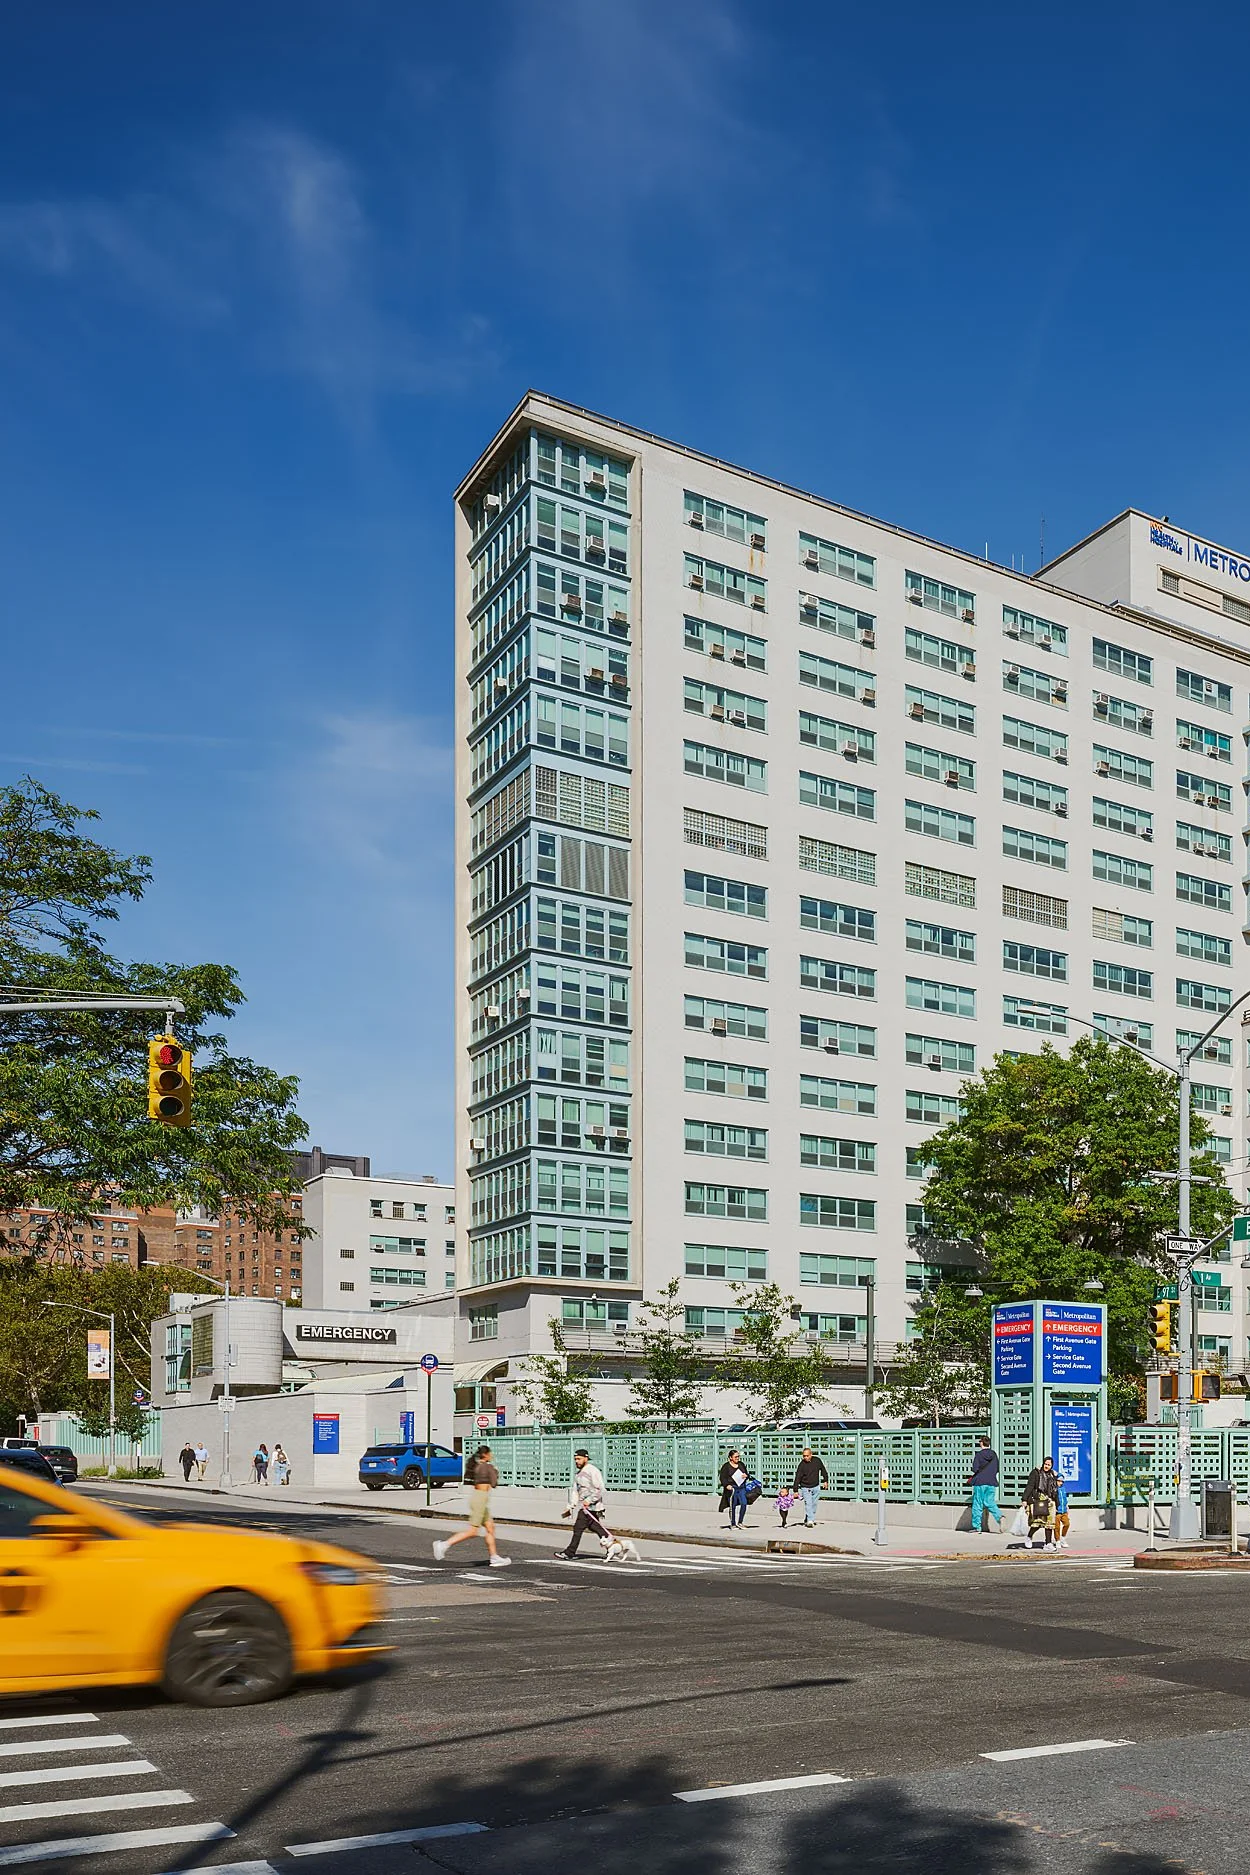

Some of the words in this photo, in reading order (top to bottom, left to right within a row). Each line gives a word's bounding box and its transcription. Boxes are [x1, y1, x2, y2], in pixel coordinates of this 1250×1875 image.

[1189, 1243, 1202, 1251] WAY
[1162, 1286, 1170, 1298] 97
[1064, 1312, 1096, 1320] Metropolitan
[301, 1326, 392, 1340] EMERGENCY
[1001, 1324, 1030, 1334] EMERGENCY
[1053, 1324, 1098, 1333] EMERGENCY
[1053, 1344, 1072, 1352] Parking
